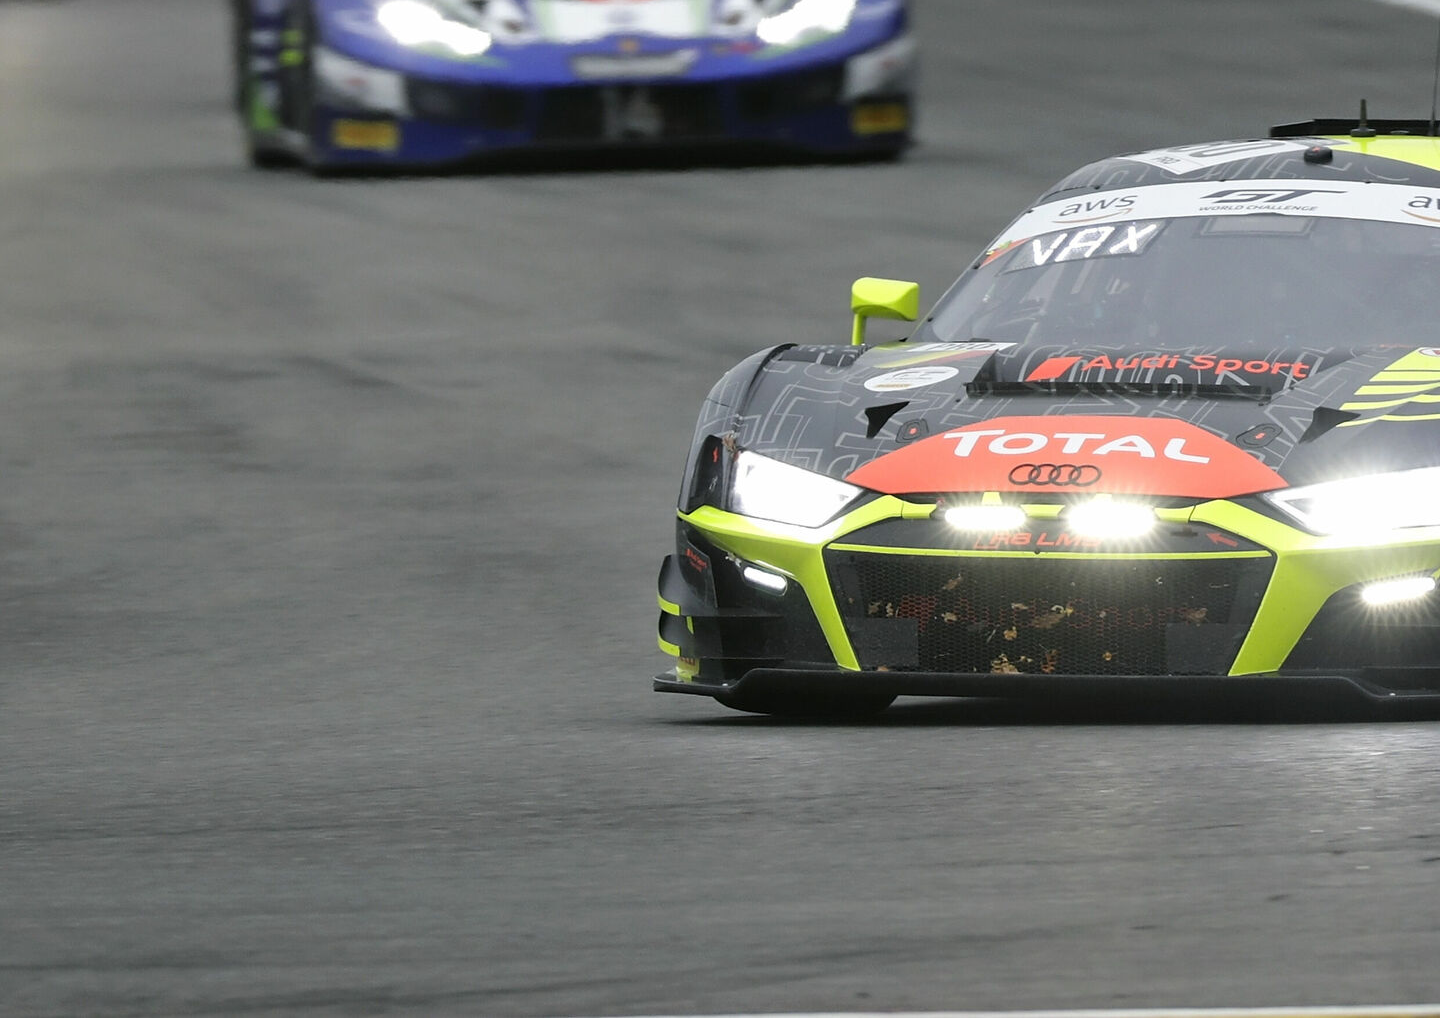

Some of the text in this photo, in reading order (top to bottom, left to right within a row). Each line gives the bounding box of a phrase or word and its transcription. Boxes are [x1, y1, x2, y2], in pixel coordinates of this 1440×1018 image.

[1059, 195, 1139, 217] aws
[1200, 189, 1348, 204] GT
[1245, 205, 1319, 213] CHALLENGE
[1032, 224, 1157, 266] VAX
[1081, 355, 1310, 379] Audi Sport
[943, 429, 1210, 464] TOTAL
[990, 532, 1033, 547] R8
